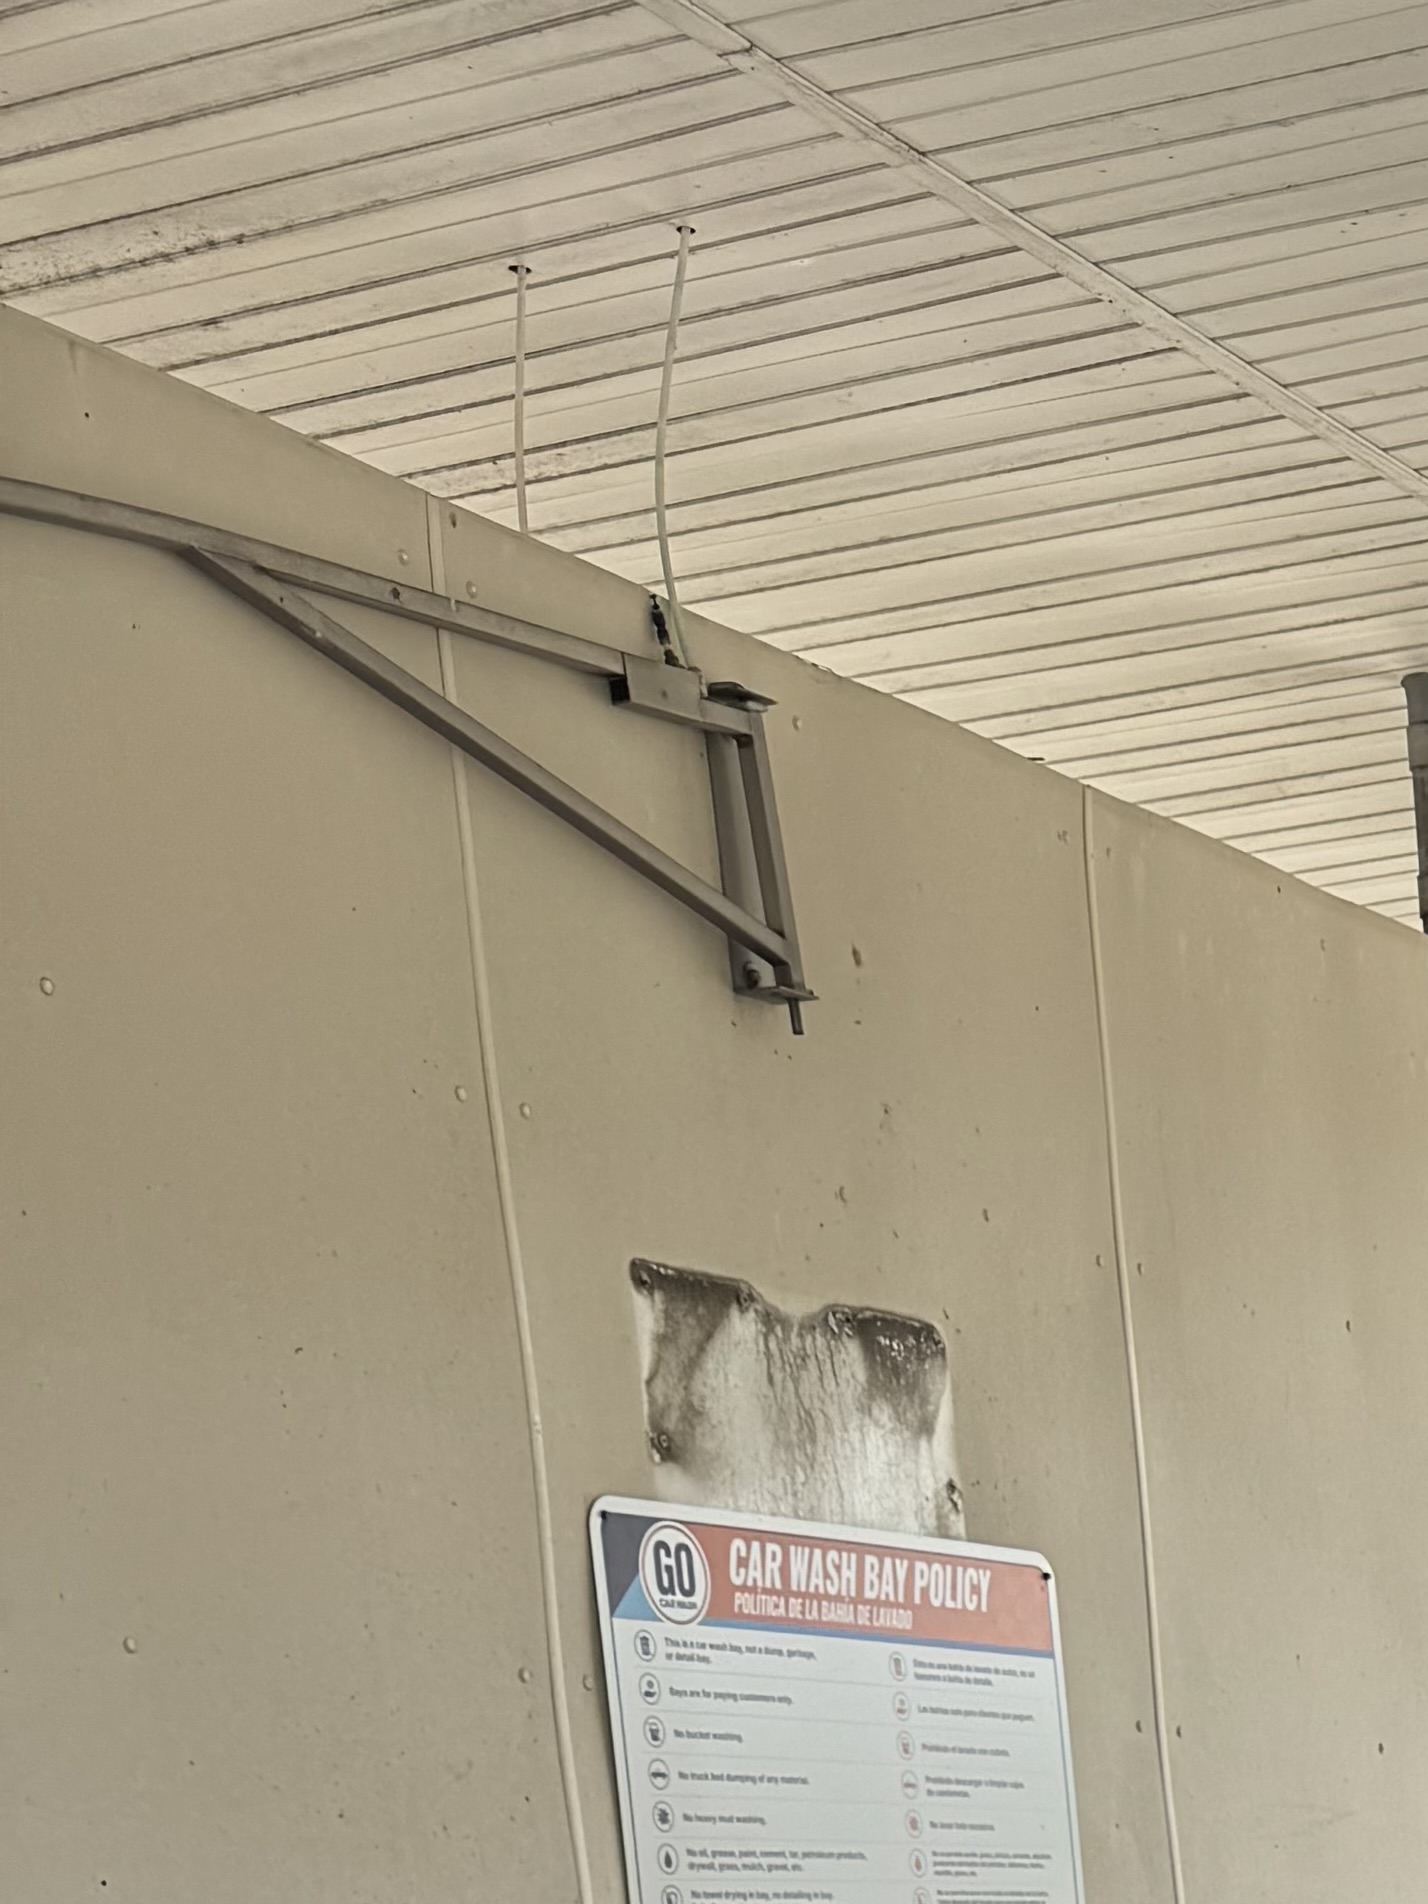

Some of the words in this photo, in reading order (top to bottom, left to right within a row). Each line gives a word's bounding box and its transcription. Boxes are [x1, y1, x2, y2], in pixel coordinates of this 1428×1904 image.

[653, 1540, 696, 1598] GO
[729, 1537, 782, 1590] CAR
[789, 1544, 857, 1598] WASH
[863, 1554, 908, 1604] BAY
[913, 1561, 991, 1613] POLICY
[734, 1588, 786, 1617] POLÍTICA
[788, 1596, 803, 1619] DE
[805, 1599, 819, 1621] LA
[857, 1604, 872, 1627] DE
[873, 1605, 913, 1630] LAVADO
